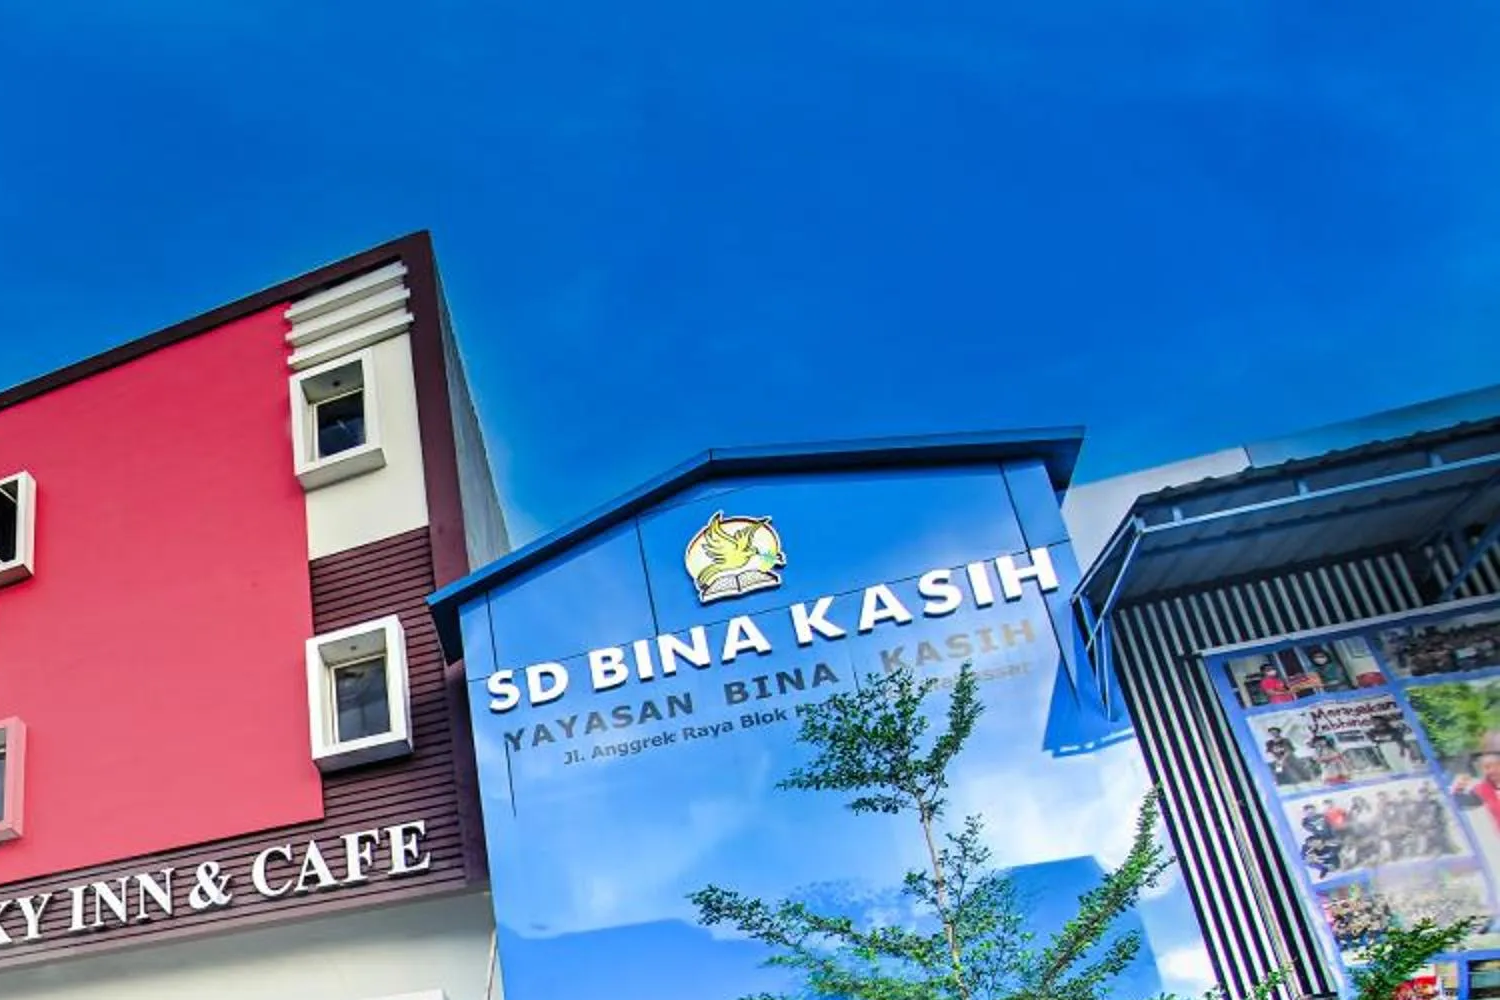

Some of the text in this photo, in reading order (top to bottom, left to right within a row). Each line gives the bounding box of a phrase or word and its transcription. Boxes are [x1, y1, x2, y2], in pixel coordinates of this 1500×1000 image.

[486, 546, 1061, 713] SD BINA KASIH
[504, 619, 1037, 752] YAYASAN BINA KASIH
[591, 730, 677, 760] Anggrek
[682, 719, 734, 740] Raya
[740, 707, 788, 729] Blok
[67, 868, 176, 933] INN
[188, 859, 233, 910] &
[251, 819, 432, 900] CAFE
